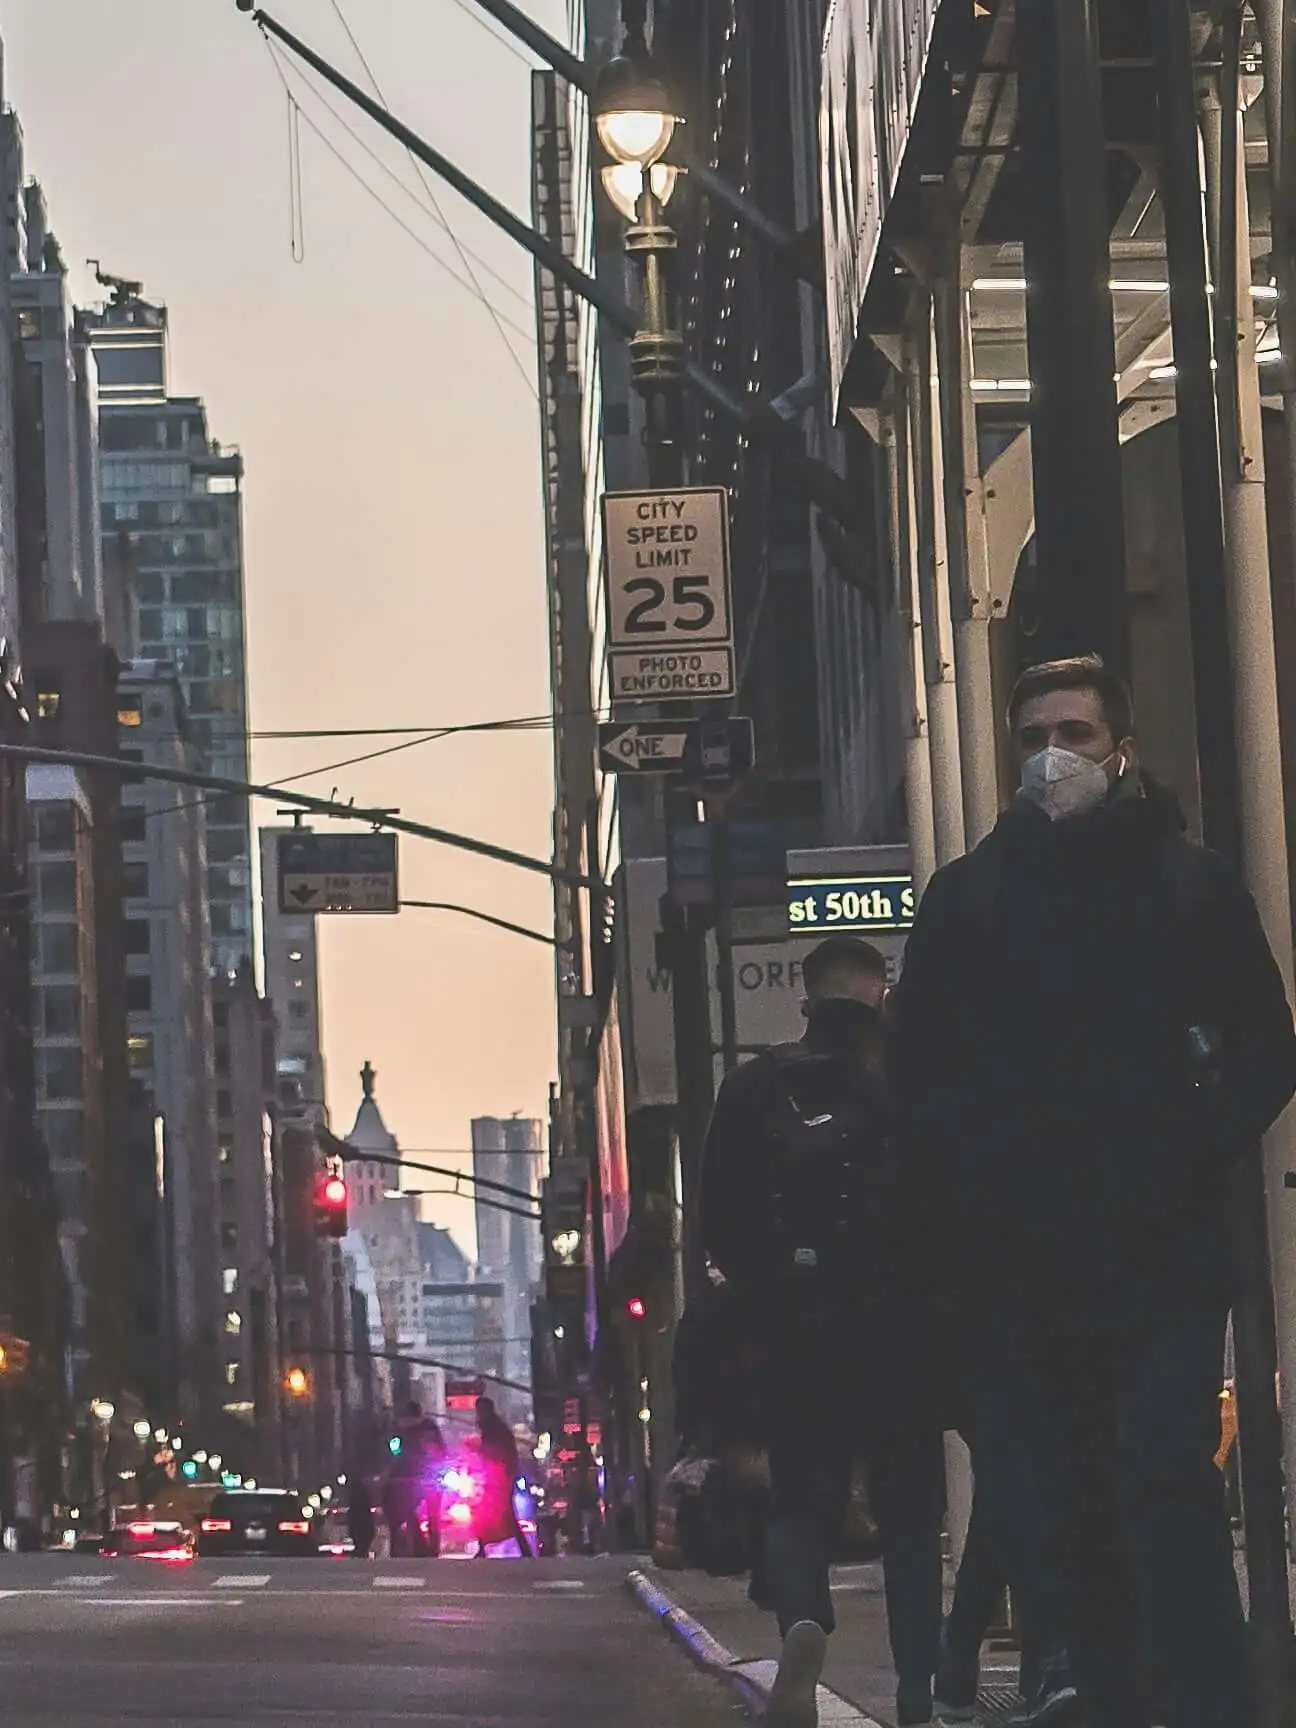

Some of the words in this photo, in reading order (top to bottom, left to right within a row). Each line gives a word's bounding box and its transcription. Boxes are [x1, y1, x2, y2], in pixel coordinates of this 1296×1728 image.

[636, 501, 686, 520] CITY
[627, 525, 698, 545] SPEED
[636, 549, 692, 569] LIMIT
[622, 575, 716, 634] 25
[639, 655, 702, 674] PHOTO
[620, 672, 722, 692] ENFORCED
[619, 737, 665, 757] ONE
[789, 894, 819, 922] st
[825, 889, 893, 920] 50th
